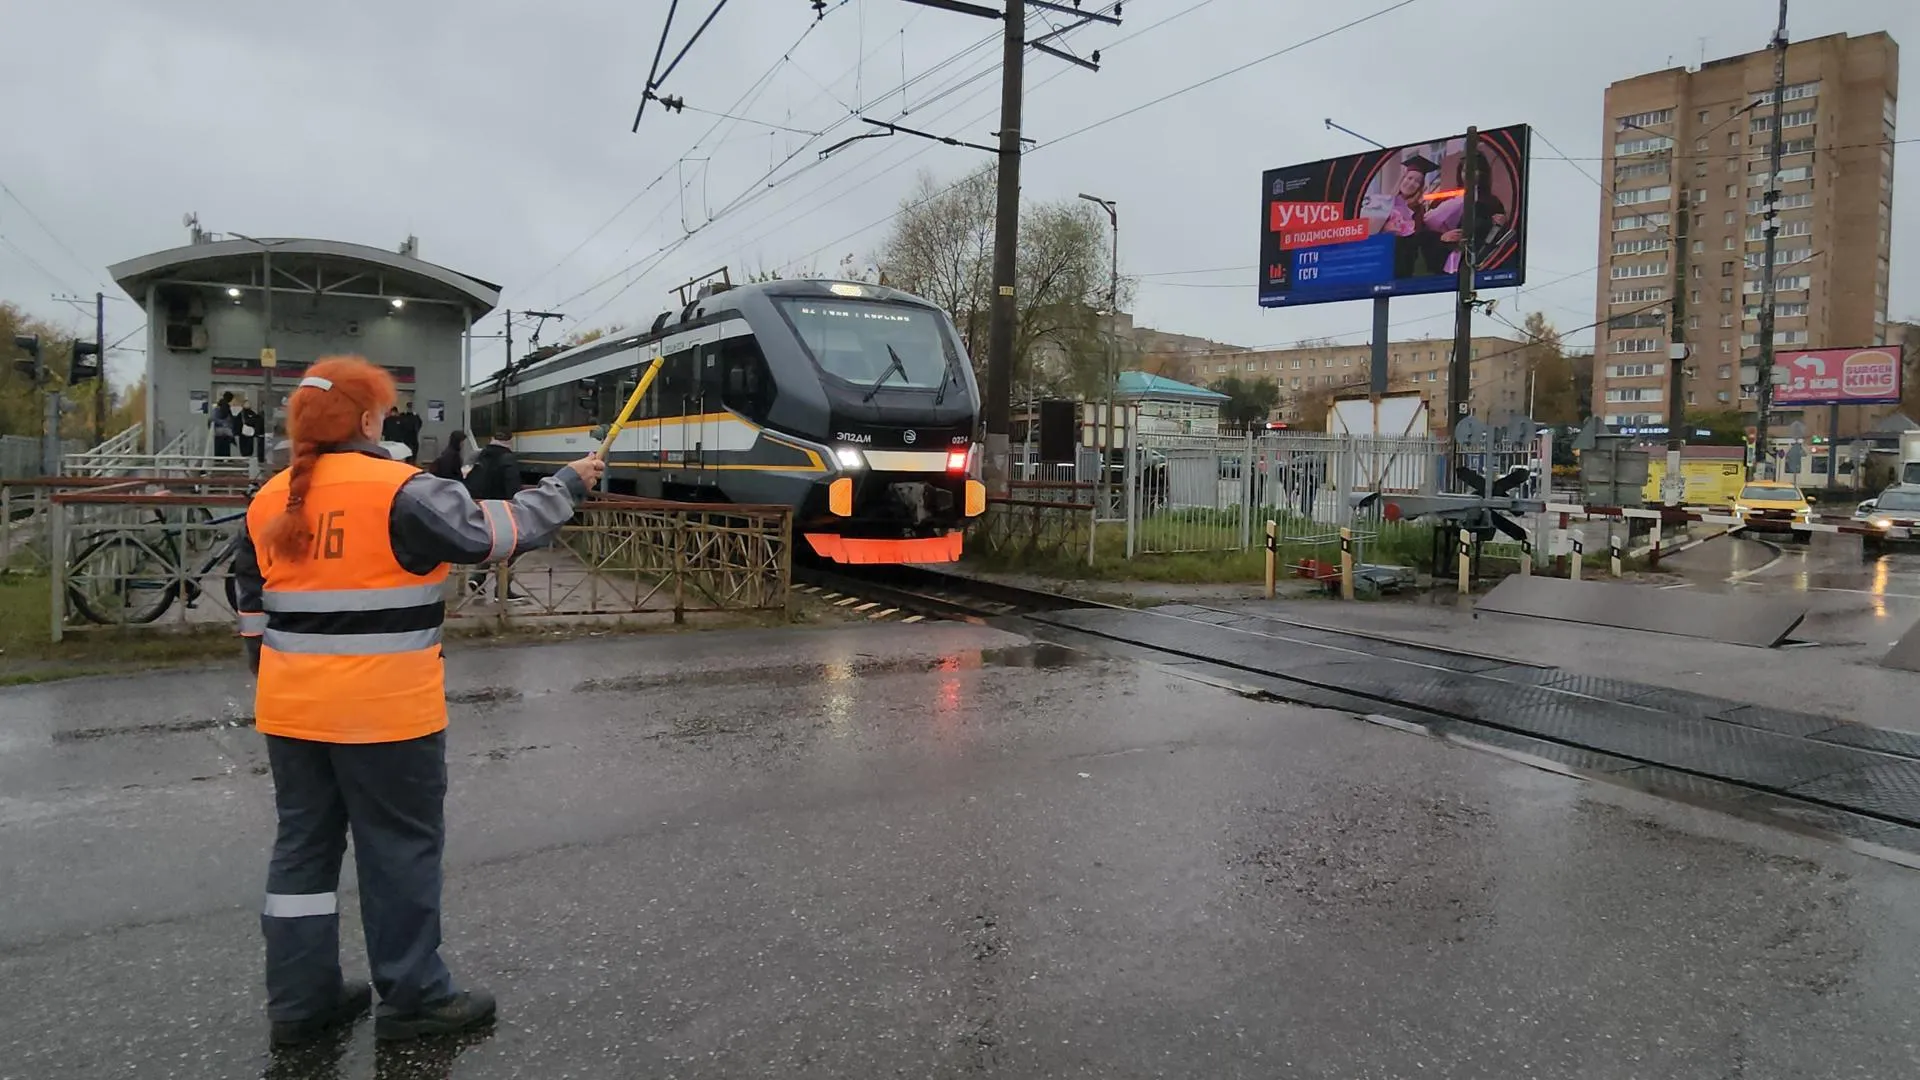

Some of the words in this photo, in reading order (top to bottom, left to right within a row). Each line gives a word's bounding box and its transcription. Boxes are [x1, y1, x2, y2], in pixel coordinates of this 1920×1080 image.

[1278, 204, 1339, 227] УЧУСЬ
[1293, 224, 1363, 243] ПОДМОСКОВЬЕ
[1299, 251, 1319, 265] ГГТУ
[1298, 267, 1318, 281] ГСГУ
[1845, 375, 1892, 386] KING
[836, 432, 872, 443] ЭП2ДМ
